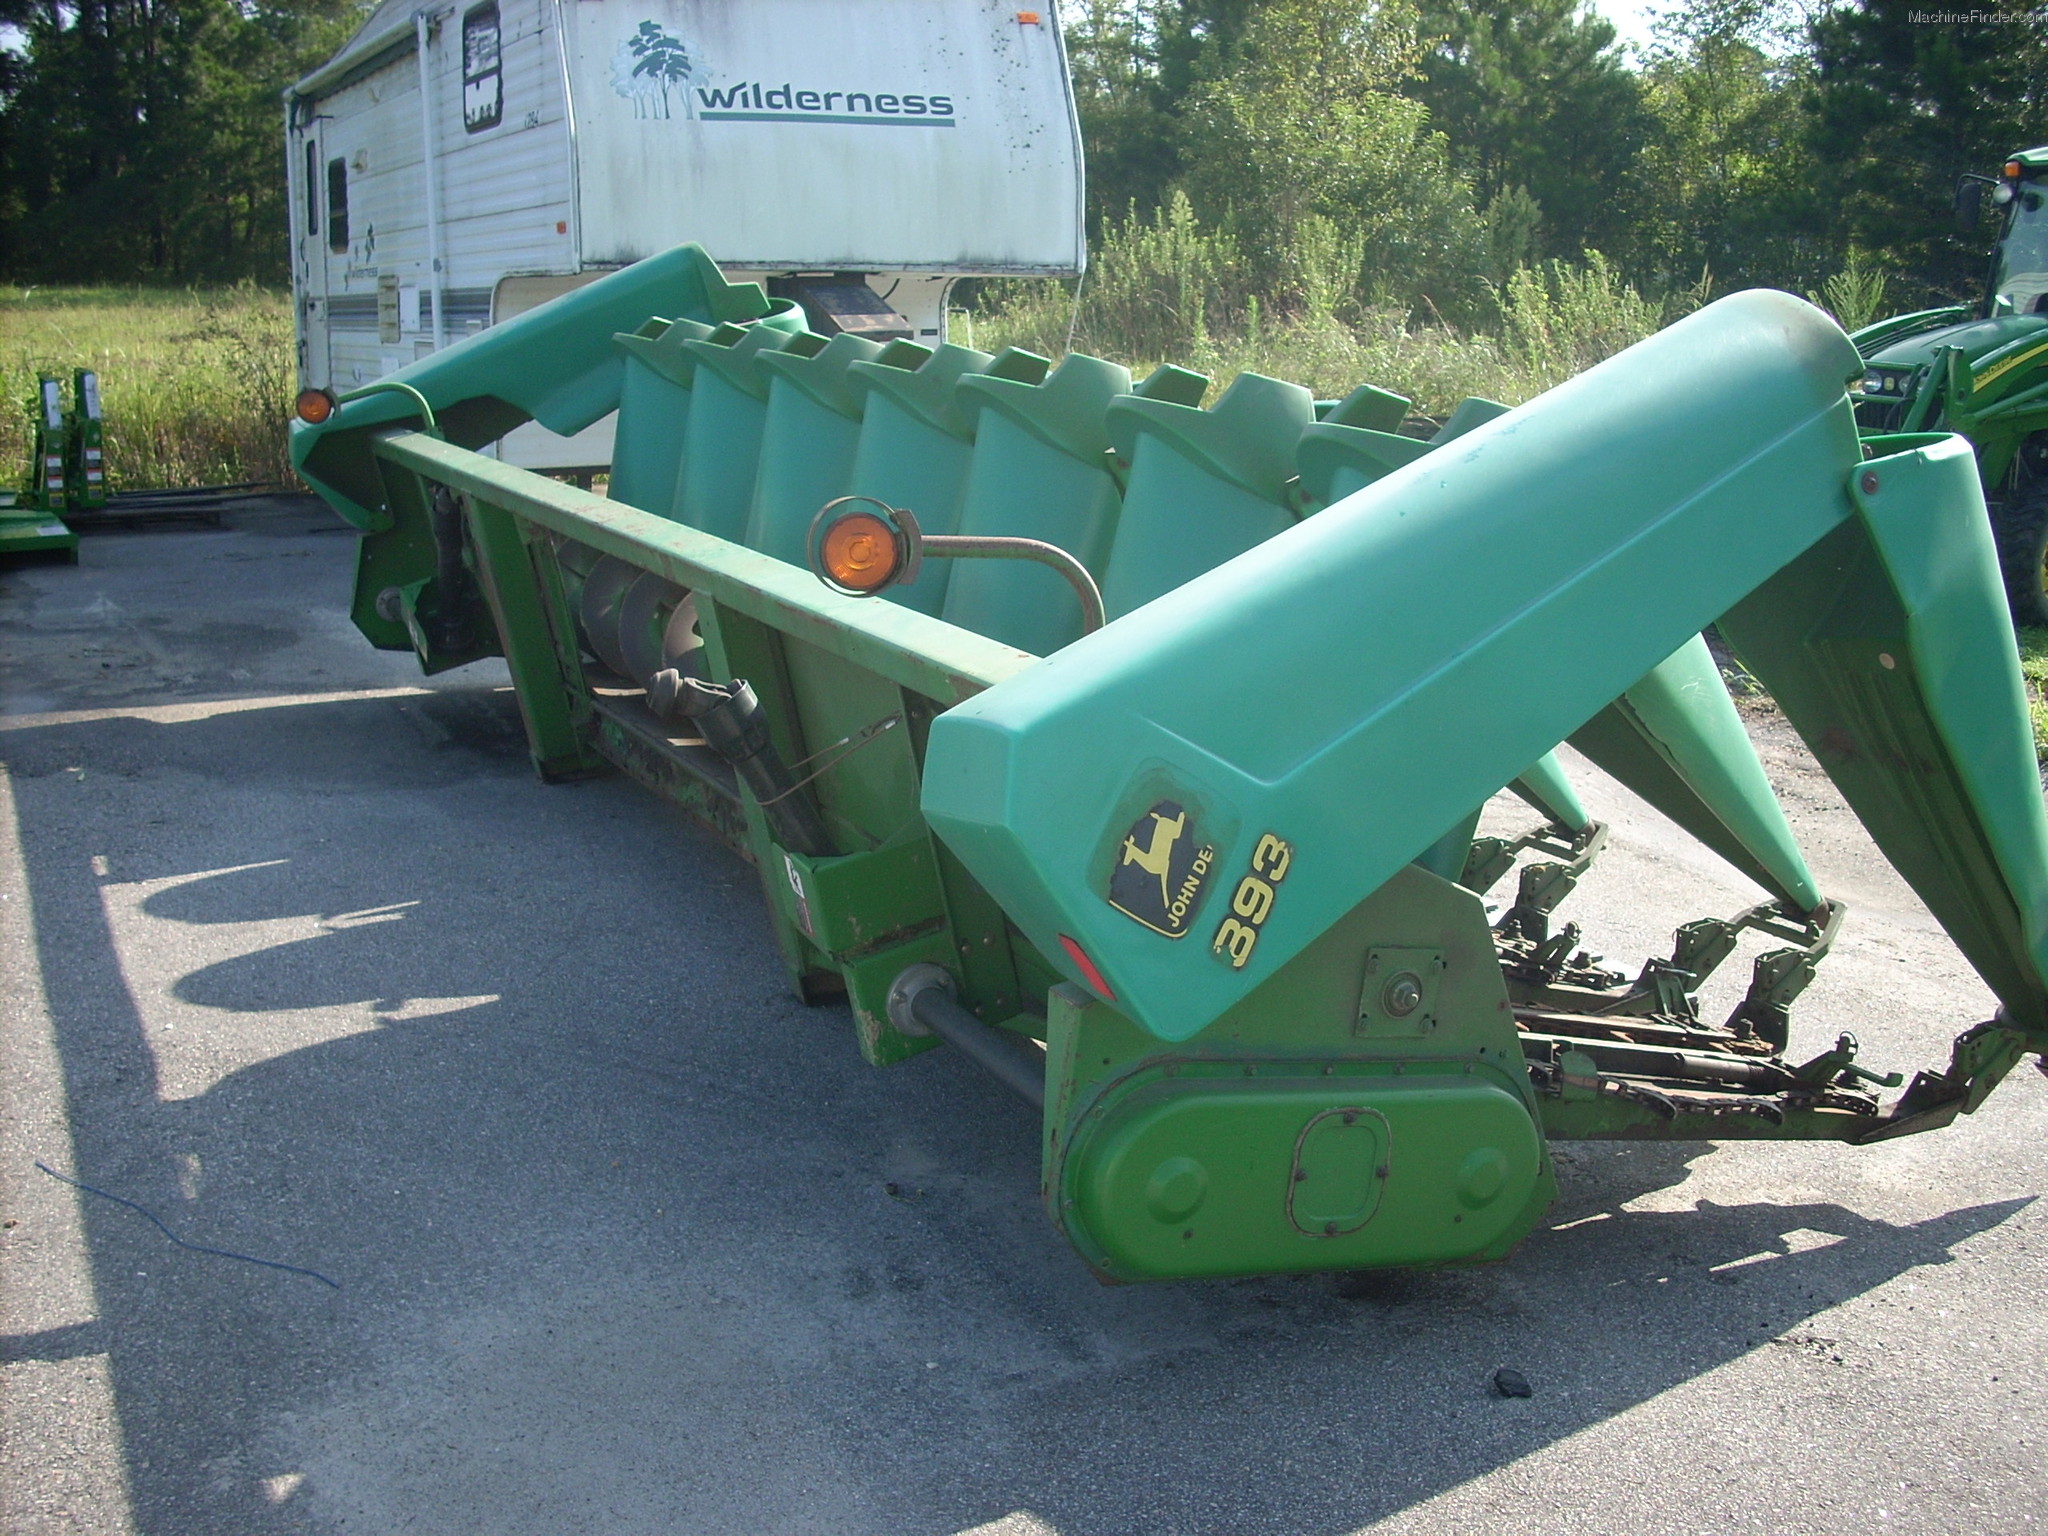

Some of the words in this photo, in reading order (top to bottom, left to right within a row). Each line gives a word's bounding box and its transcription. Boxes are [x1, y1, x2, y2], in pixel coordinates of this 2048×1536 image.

[697, 81, 954, 116] Wilderness
[1167, 874, 1200, 928] JOHN
[1192, 844, 1214, 875] DE
[1213, 832, 1291, 969] 393
